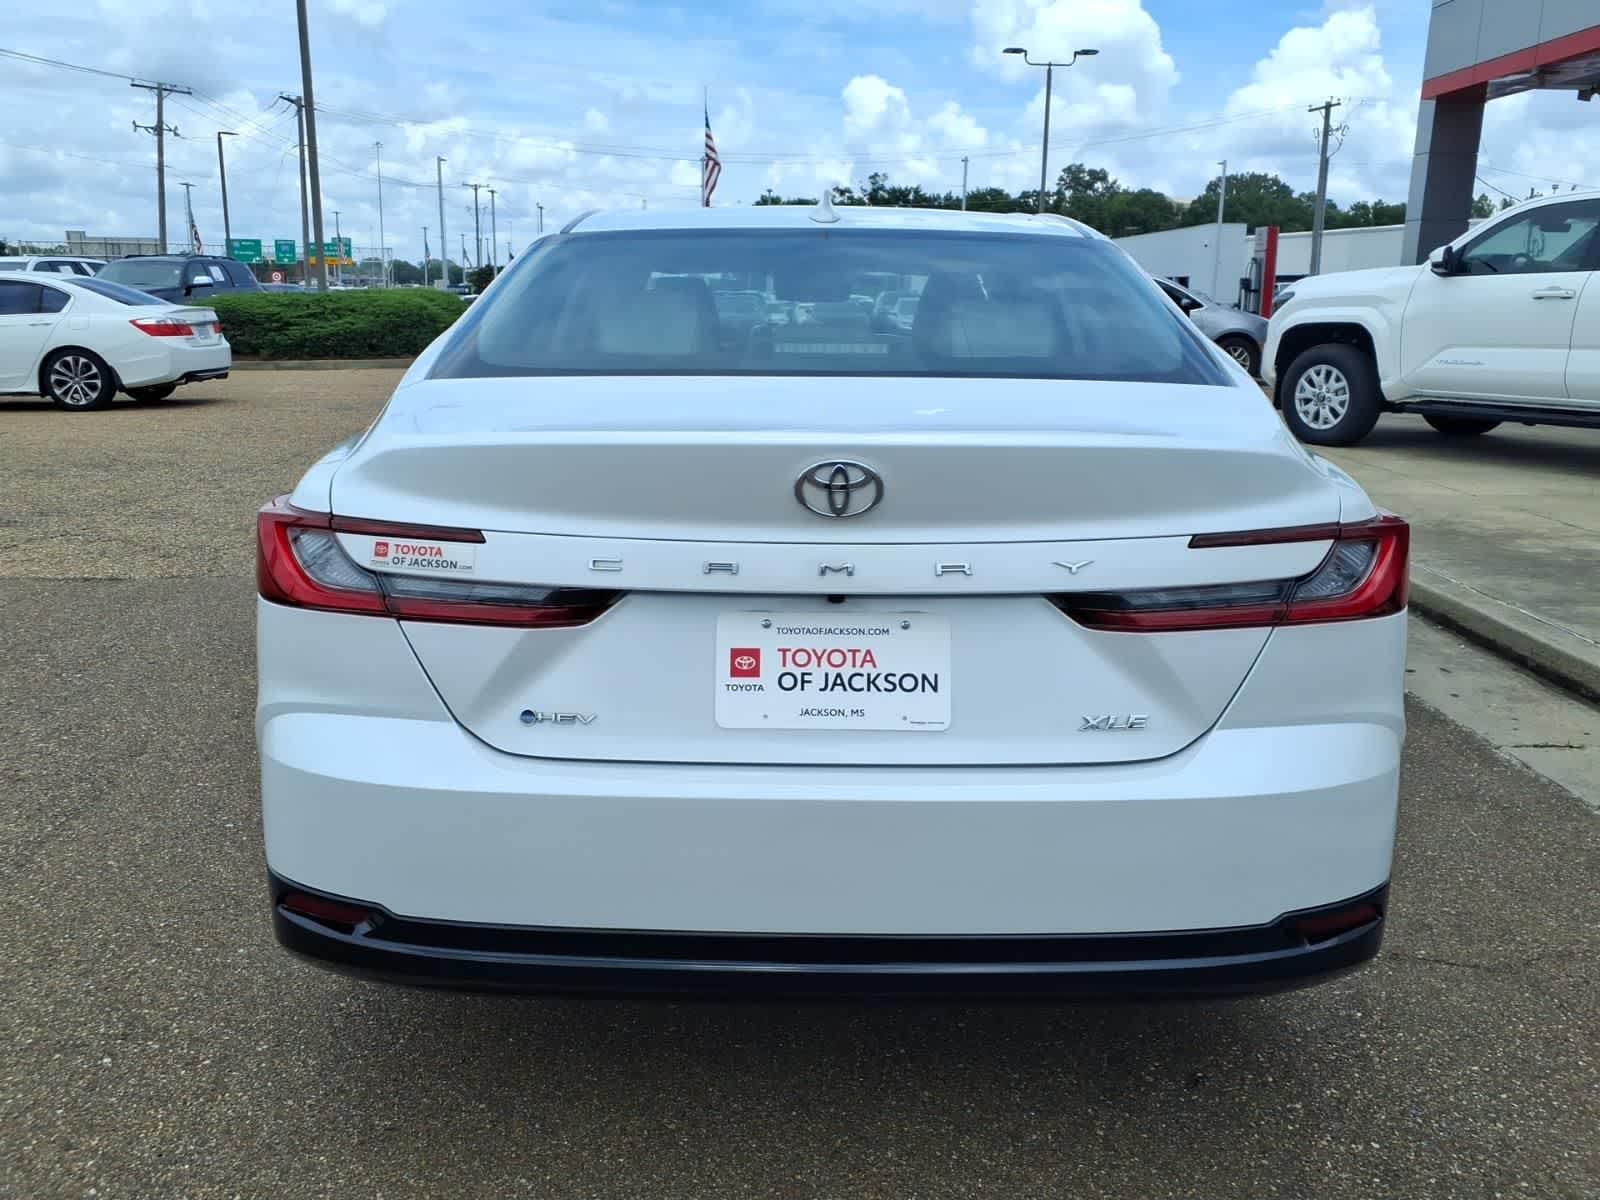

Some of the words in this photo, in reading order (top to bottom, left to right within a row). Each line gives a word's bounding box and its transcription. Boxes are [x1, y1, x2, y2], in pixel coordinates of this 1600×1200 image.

[394, 544, 443, 557] TOYOTA
[392, 557, 406, 565] OF
[407, 558, 458, 569] JACKSON
[588, 557, 1095, 577] CAMRY
[776, 627, 890, 636] TOYOTAOFJACKSON.COM
[777, 648, 877, 669] TOYOTA
[726, 683, 764, 692] TOYOTA
[777, 672, 812, 692] OF
[818, 673, 939, 693] JACKSON
[536, 712, 597, 725] HEV
[800, 708, 848, 718] JACKSON,
[851, 708, 865, 717] MS
[1080, 714, 1149, 730] XLE
